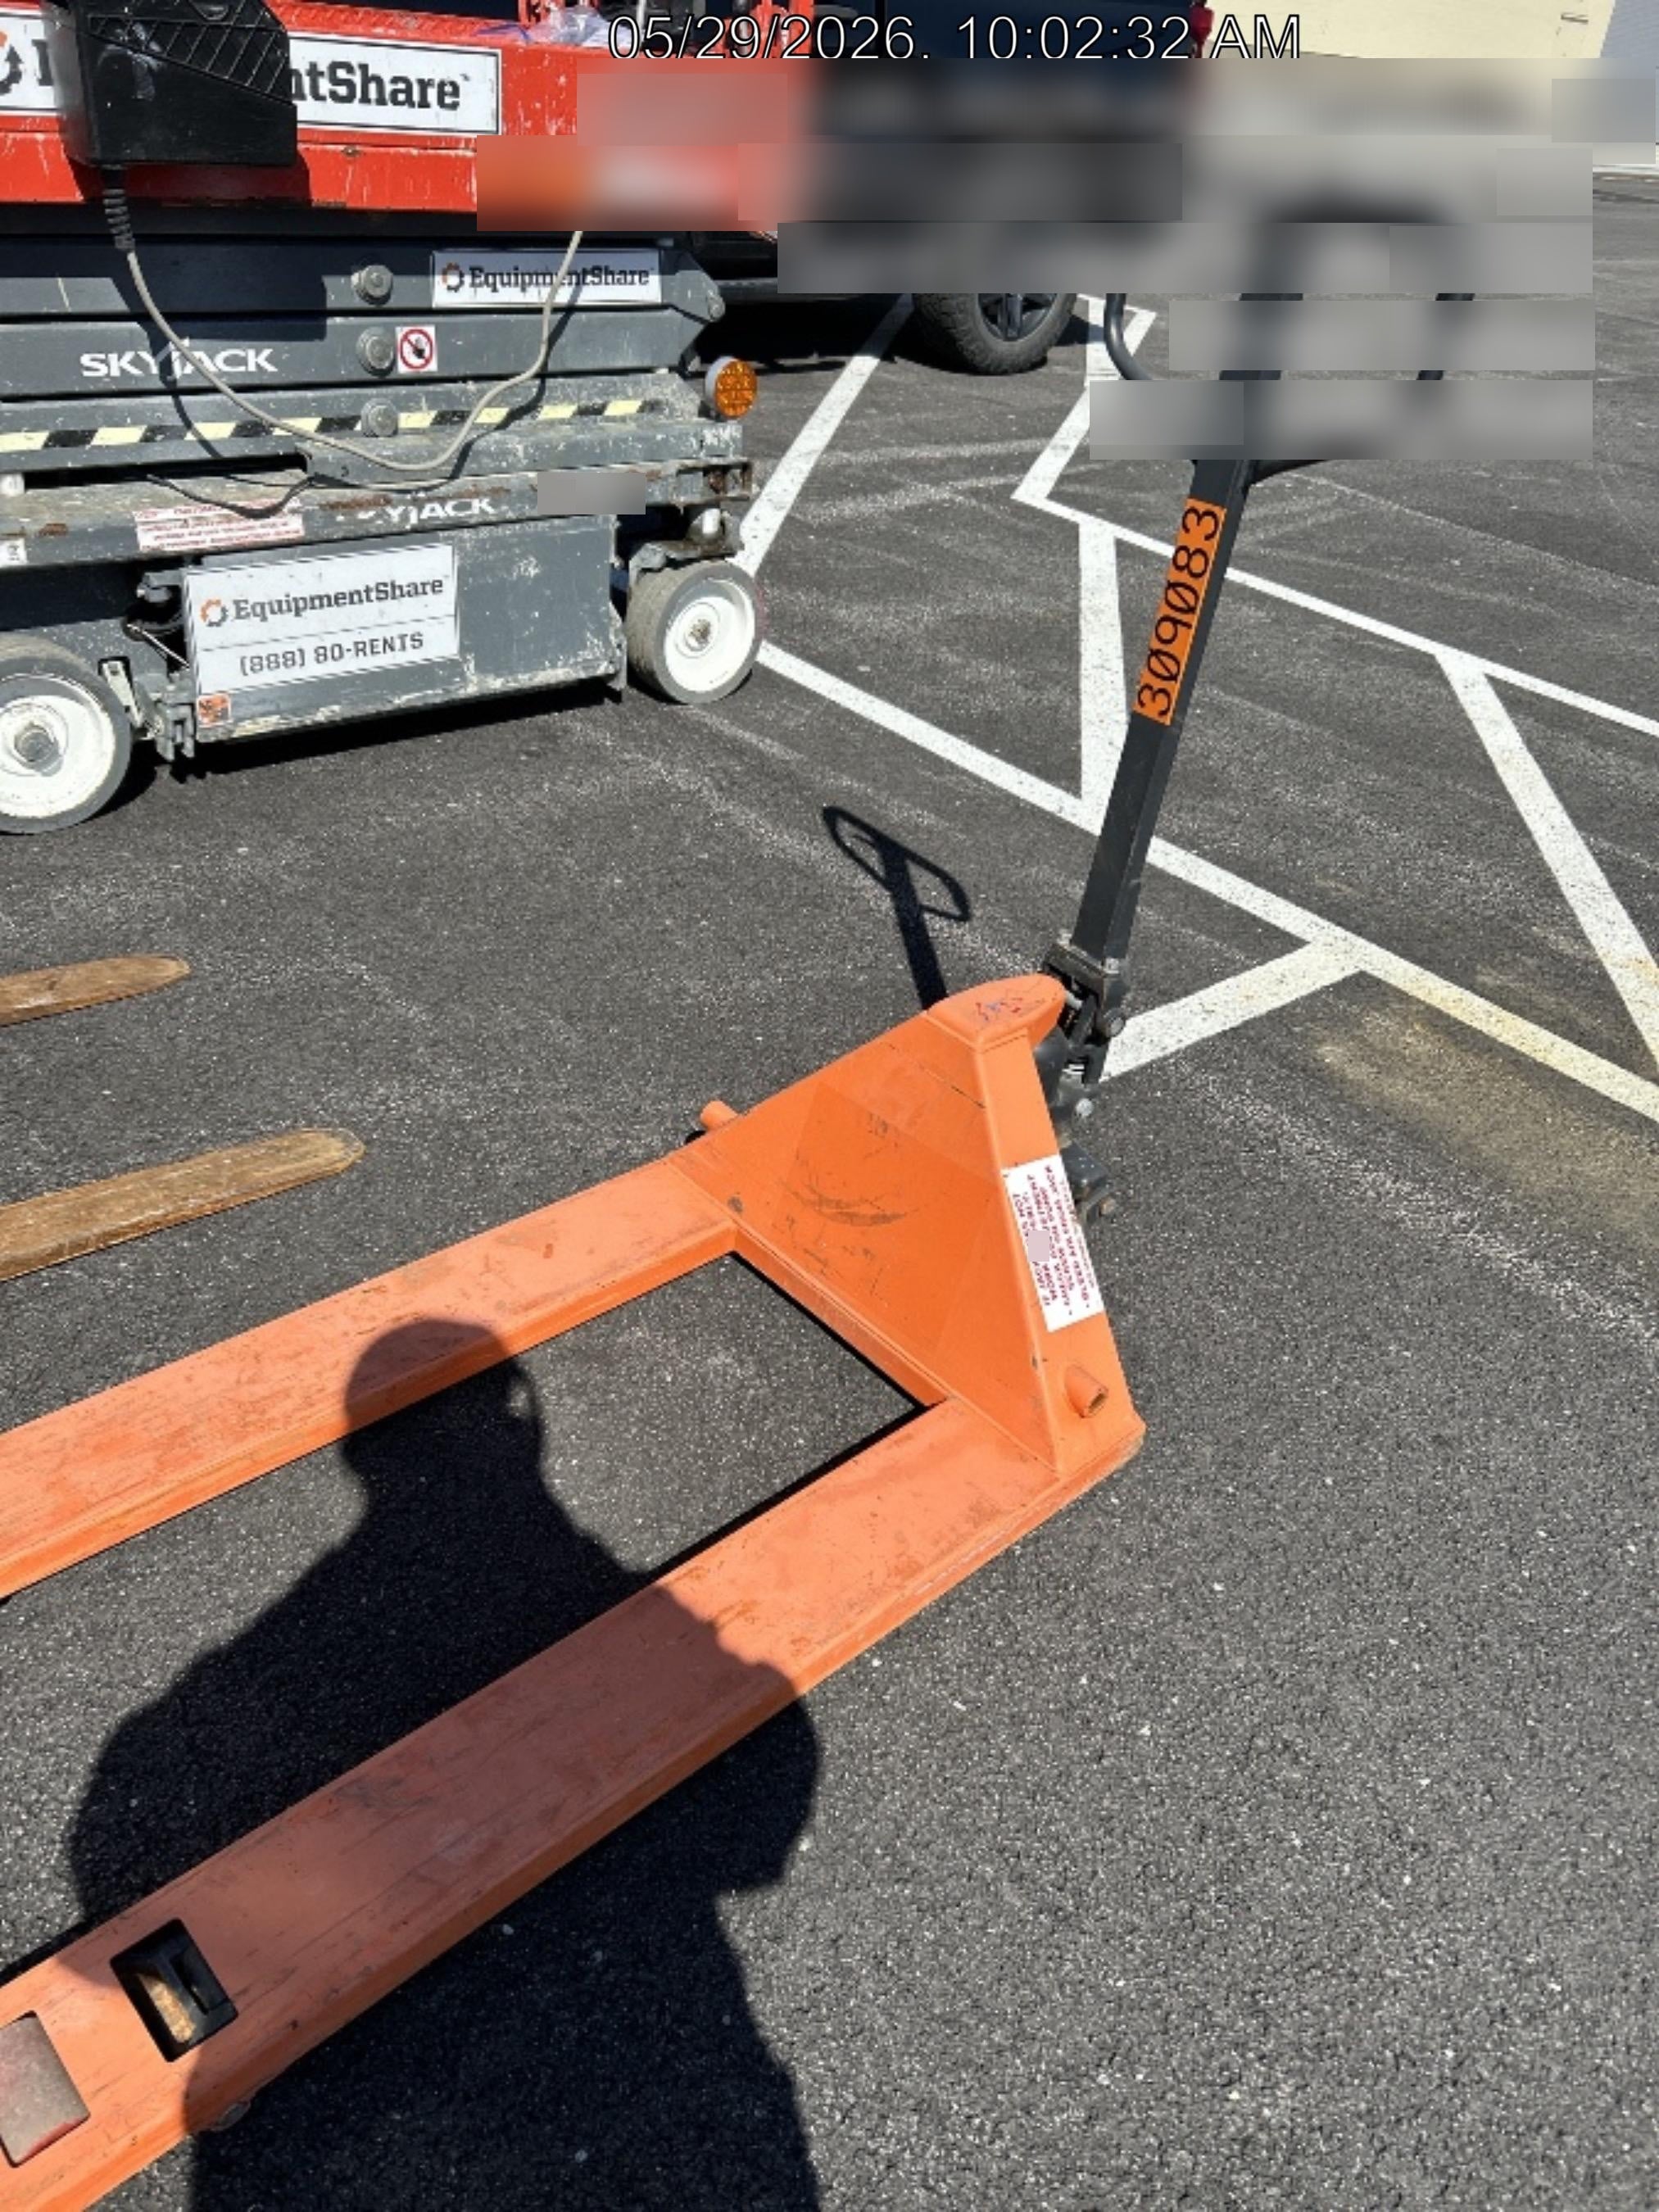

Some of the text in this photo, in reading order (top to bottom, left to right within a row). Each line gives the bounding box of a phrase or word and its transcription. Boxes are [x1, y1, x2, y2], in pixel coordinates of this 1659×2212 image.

[80, 337, 279, 379] SKYJACK
[233, 578, 443, 622] EquipmentShare
[1137, 506, 1220, 717] 309083
[240, 632, 424, 676] (888) 80-RENTS
